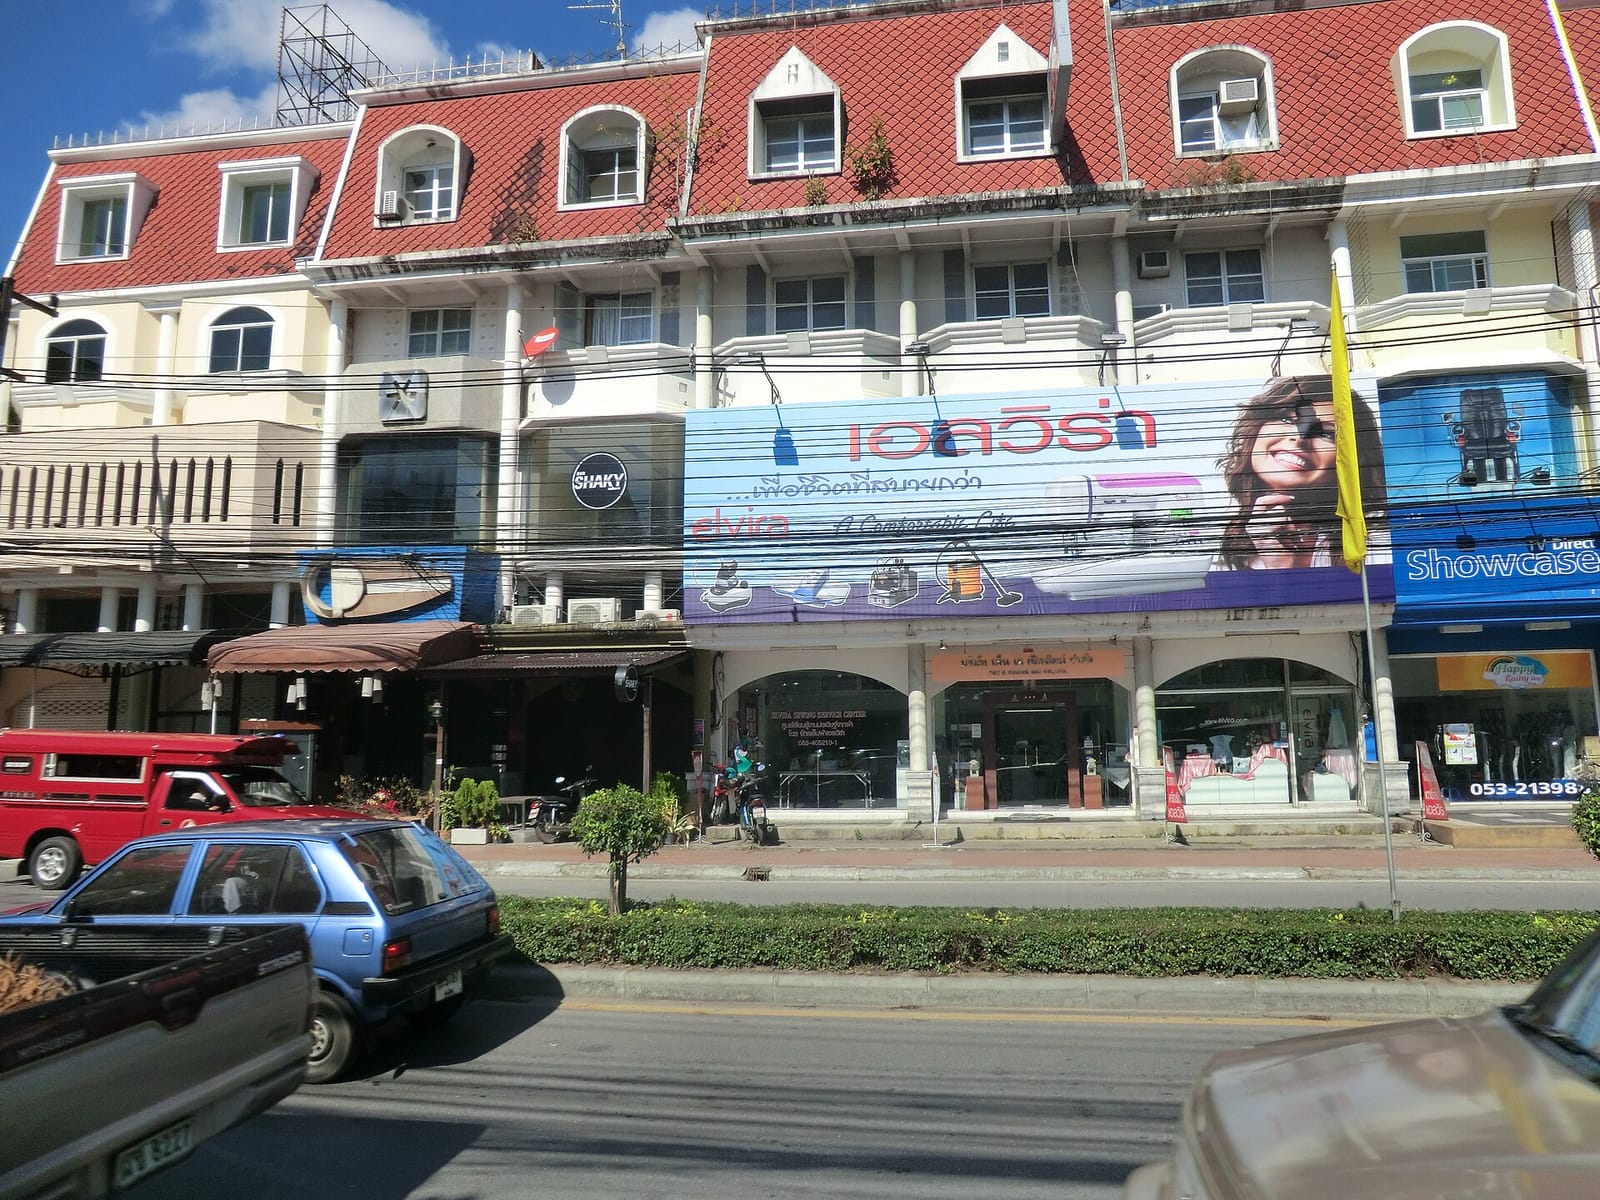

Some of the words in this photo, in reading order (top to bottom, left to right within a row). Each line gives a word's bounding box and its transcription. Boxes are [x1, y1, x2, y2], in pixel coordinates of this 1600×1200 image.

[850, 398, 1157, 462] เอลวิร่า
[574, 473, 625, 490] SHAKY
[691, 506, 790, 542] elvira
[1526, 539, 1546, 552] TV
[1552, 538, 1597, 551] Direct
[1406, 548, 1600, 580] Showcase
[1494, 664, 1535, 675] Happy
[1505, 674, 1529, 683] Rainy
[1302, 708, 1315, 748] elvira
